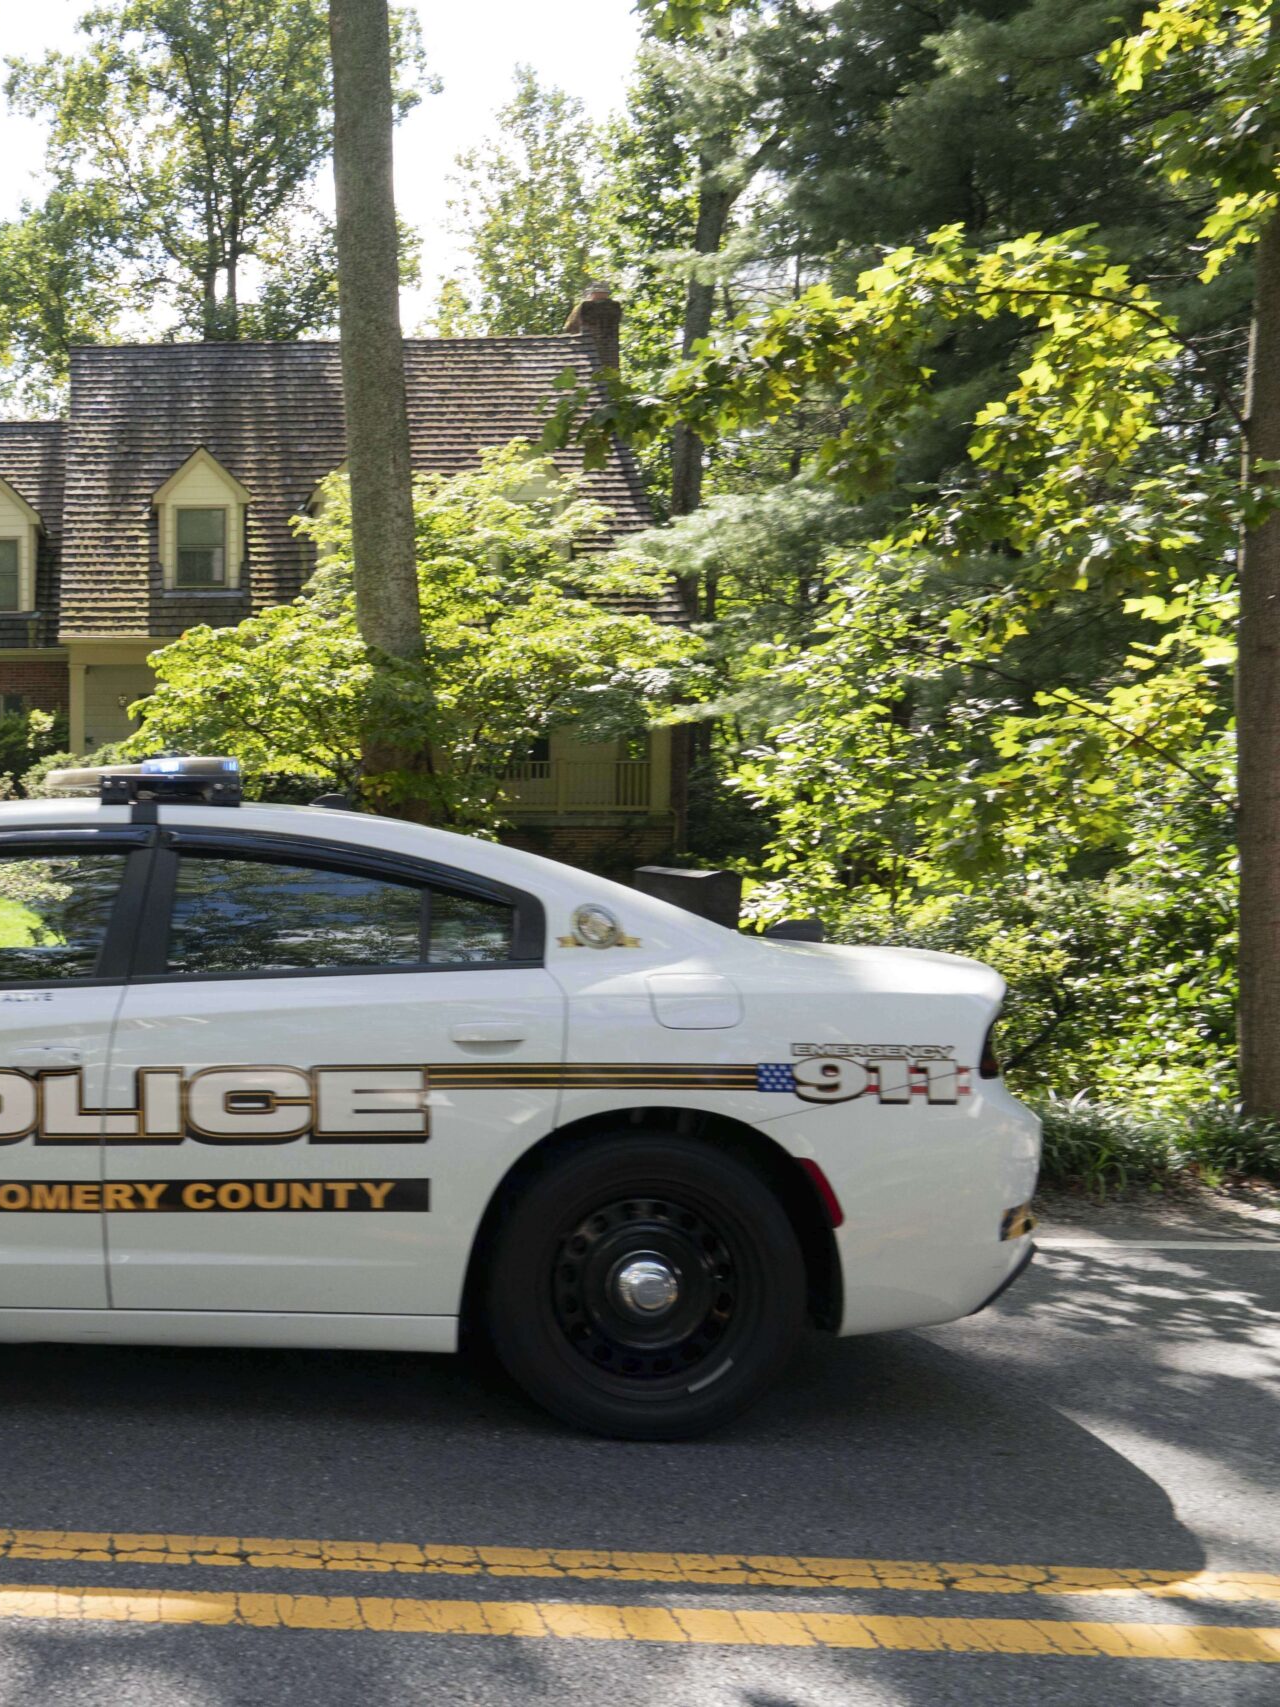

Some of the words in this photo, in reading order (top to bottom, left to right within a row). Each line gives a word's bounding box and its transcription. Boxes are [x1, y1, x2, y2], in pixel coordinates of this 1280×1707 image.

[791, 1043, 955, 1058] EMERGENCY
[792, 1056, 958, 1105] 911
[182, 1182, 394, 1210] COUNTY
